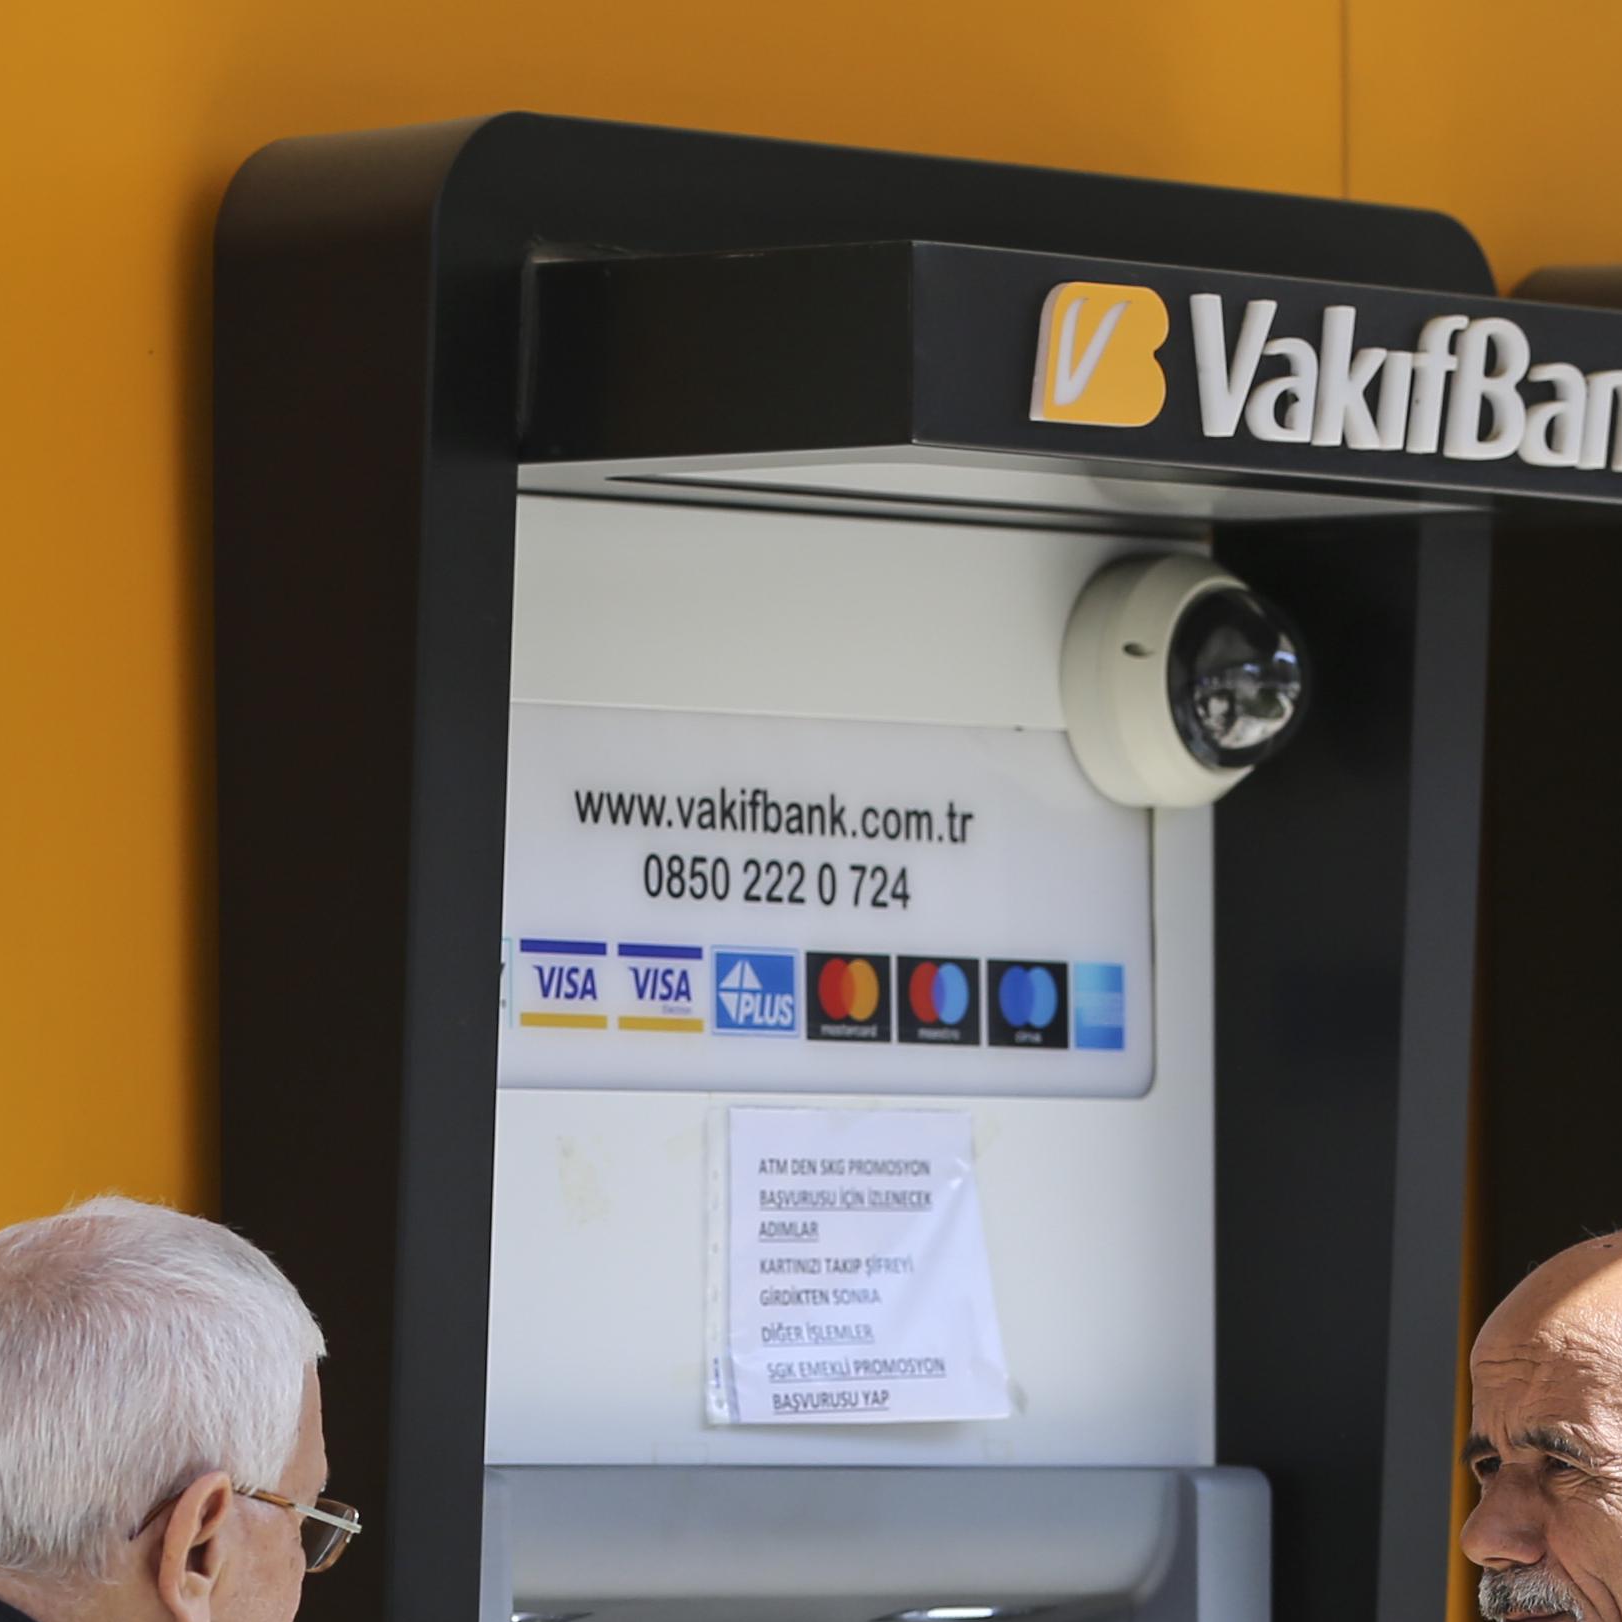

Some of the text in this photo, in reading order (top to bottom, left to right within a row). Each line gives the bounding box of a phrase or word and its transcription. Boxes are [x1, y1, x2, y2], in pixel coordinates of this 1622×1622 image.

[575, 787, 974, 844] www.vakifbank.com.tr
[643, 853, 912, 910] 0850 222 0 724
[533, 965, 598, 1000] VISA
[628, 966, 692, 1002] VISA
[737, 992, 794, 1026] PLUS
[758, 1158, 788, 1175] ATM
[790, 1158, 817, 1175] DEN
[848, 1159, 931, 1176] PROMOSYON
[758, 1221, 819, 1239] ADIMLAR
[759, 1257, 821, 1275] KARTINIZI
[759, 1285, 882, 1307] GİRDİKTEN SONRA
[761, 1321, 803, 1343] DİĞER
[767, 1362, 796, 1380] SGK
[854, 1357, 946, 1377] PROMOSYON
[772, 1389, 890, 1412] BAŞVURUSU YAP
